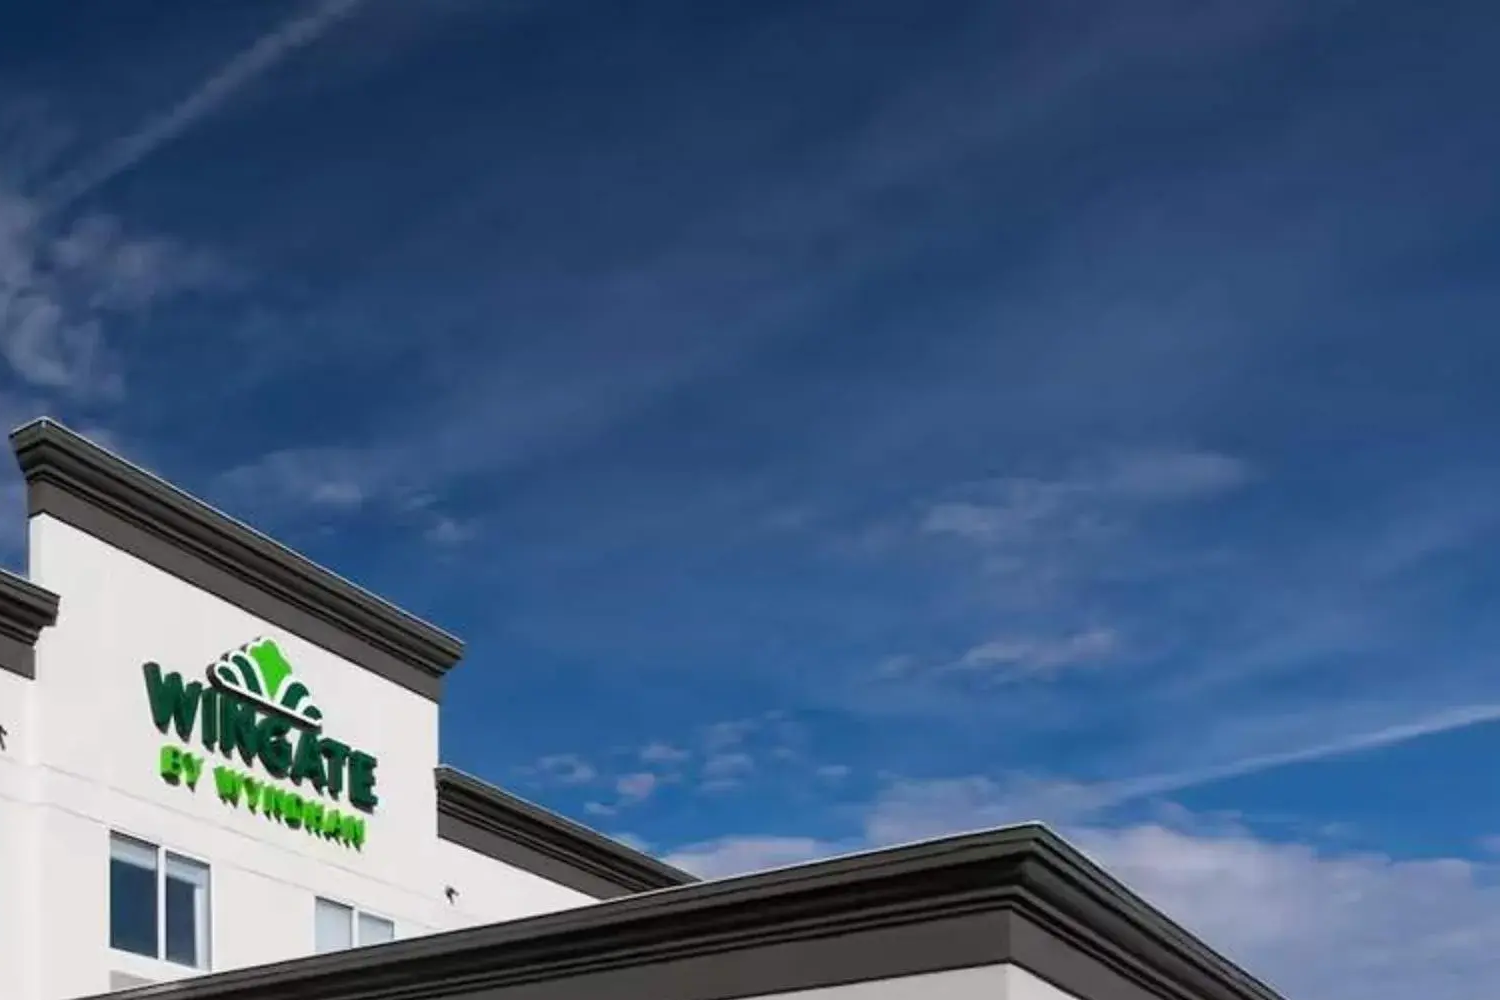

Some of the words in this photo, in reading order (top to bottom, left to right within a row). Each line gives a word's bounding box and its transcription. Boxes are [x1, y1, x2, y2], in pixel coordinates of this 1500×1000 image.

[143, 661, 378, 814] WINGATE
[160, 745, 203, 791] BY
[213, 766, 365, 852] WYNDHAM
